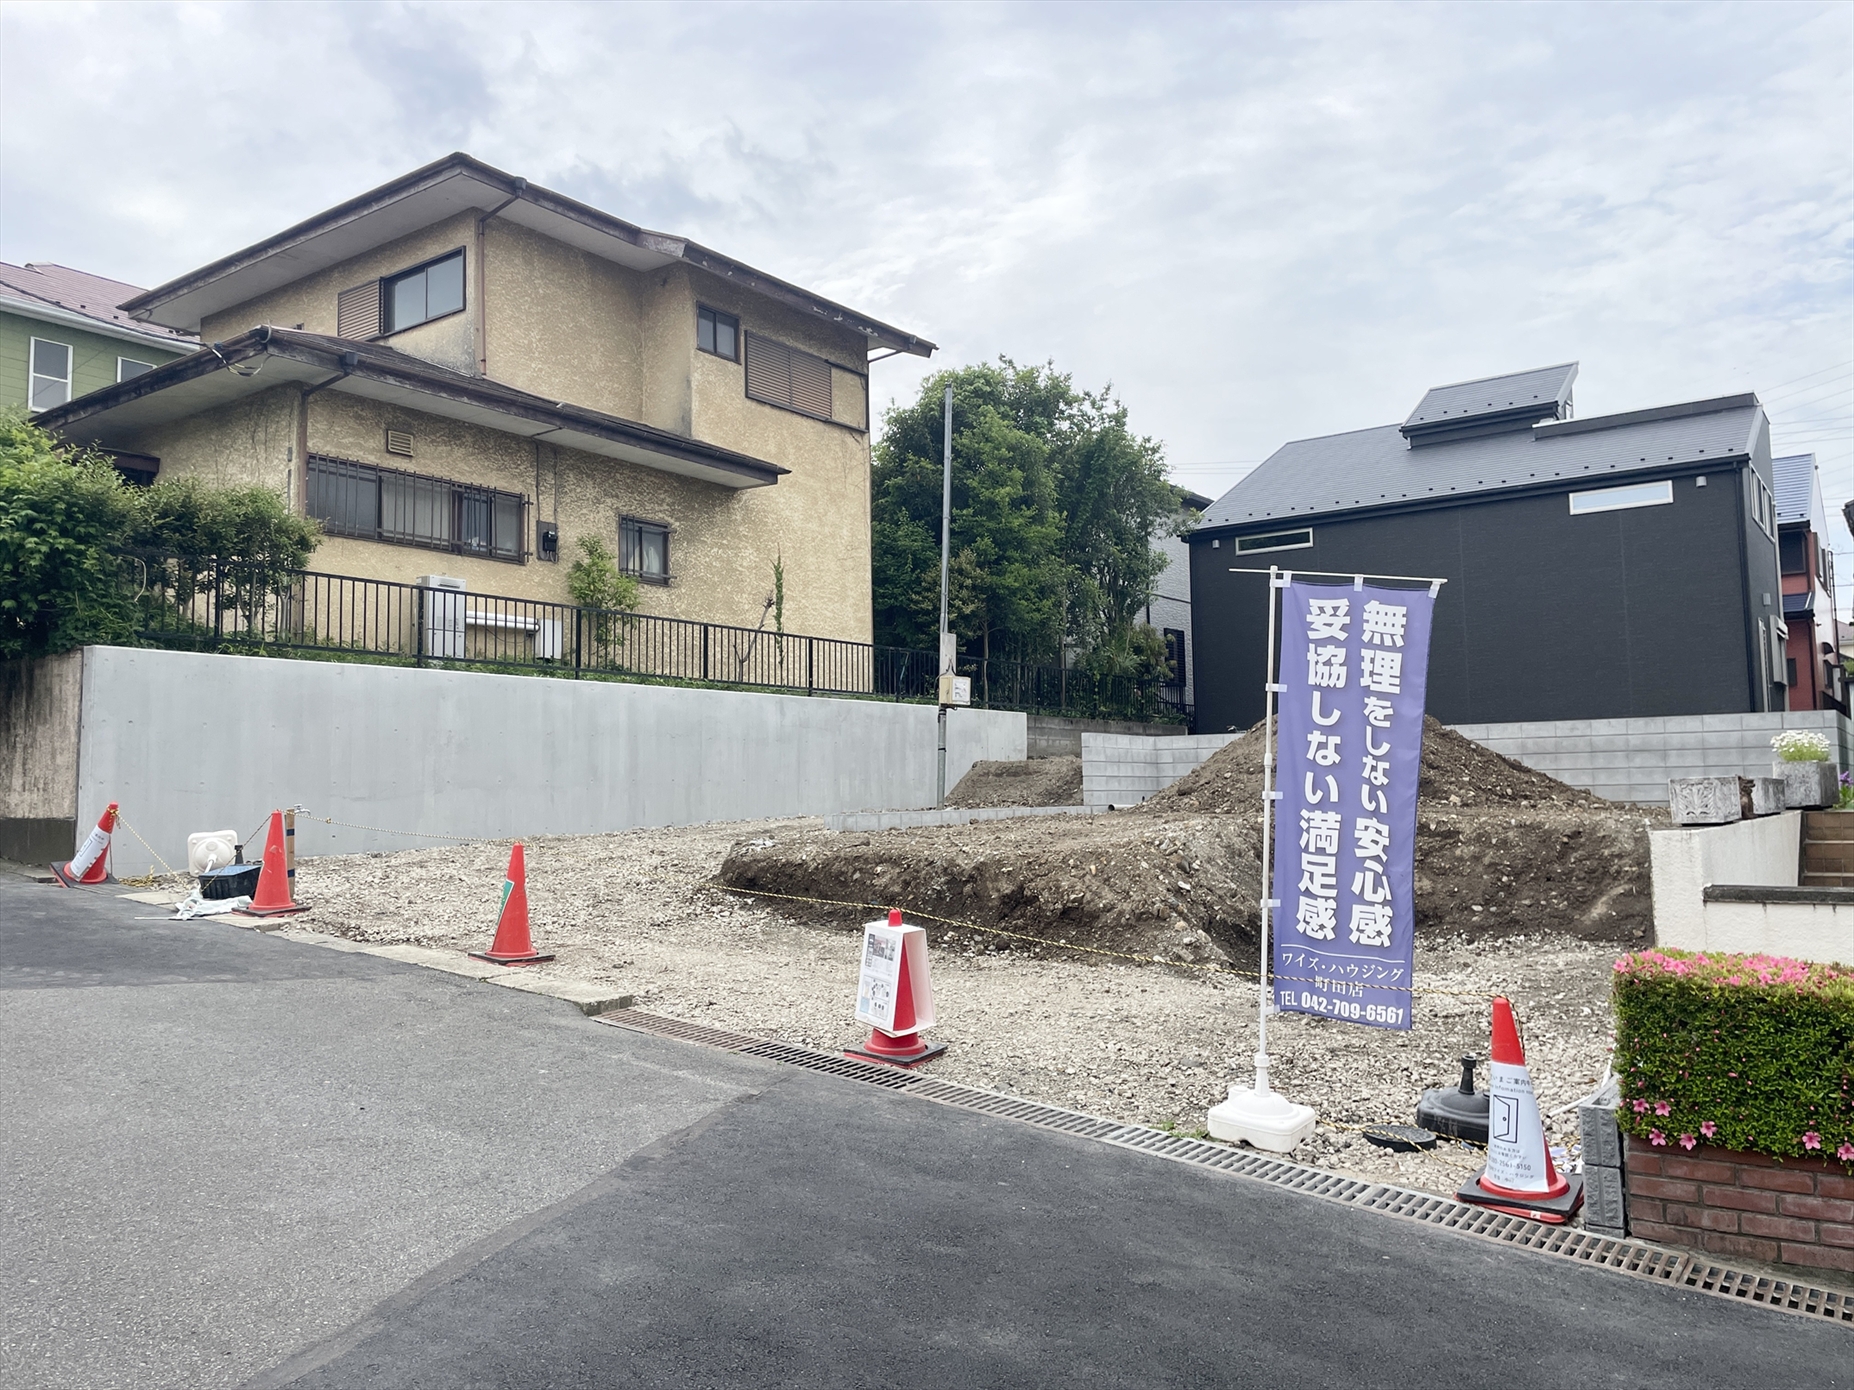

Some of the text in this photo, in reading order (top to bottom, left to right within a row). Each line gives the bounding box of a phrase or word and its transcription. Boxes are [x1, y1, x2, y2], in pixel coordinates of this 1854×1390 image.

[1296, 598, 1351, 941] 妥協しない満足感
[1349, 599, 1407, 948] 無理をしない安心感
[1282, 953, 1404, 982] ワイズ・ハウジング
[1315, 975, 1364, 998] 町田店
[1280, 991, 1404, 1025] TEL 042-709-6561
